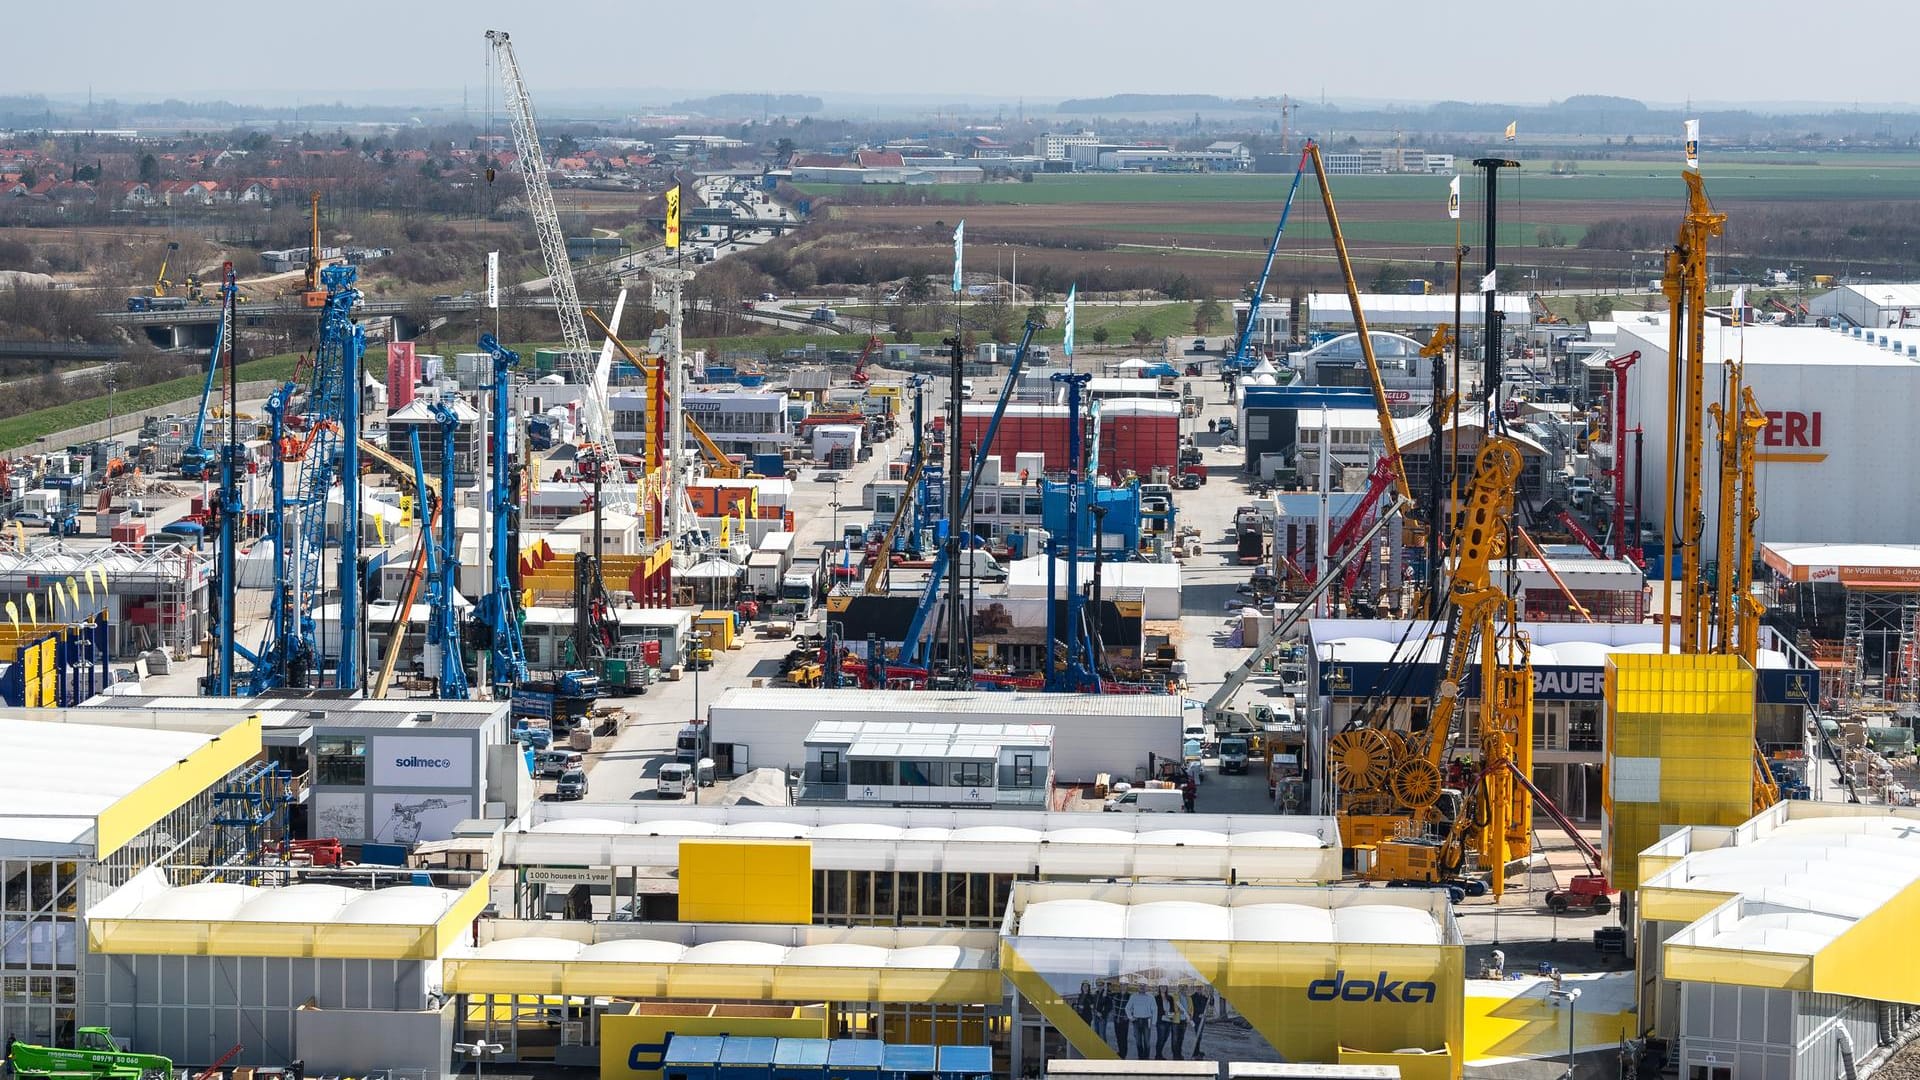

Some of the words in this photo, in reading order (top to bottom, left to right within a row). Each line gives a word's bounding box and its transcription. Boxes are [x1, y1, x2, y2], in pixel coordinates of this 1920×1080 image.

[1383, 392, 1407, 401] NGELIS
[396, 756, 442, 768] soilmec
[550, 872, 577, 880] houses
[578, 872, 585, 880] in
[591, 874, 609, 882] year
[1308, 970, 1436, 1003] doka
